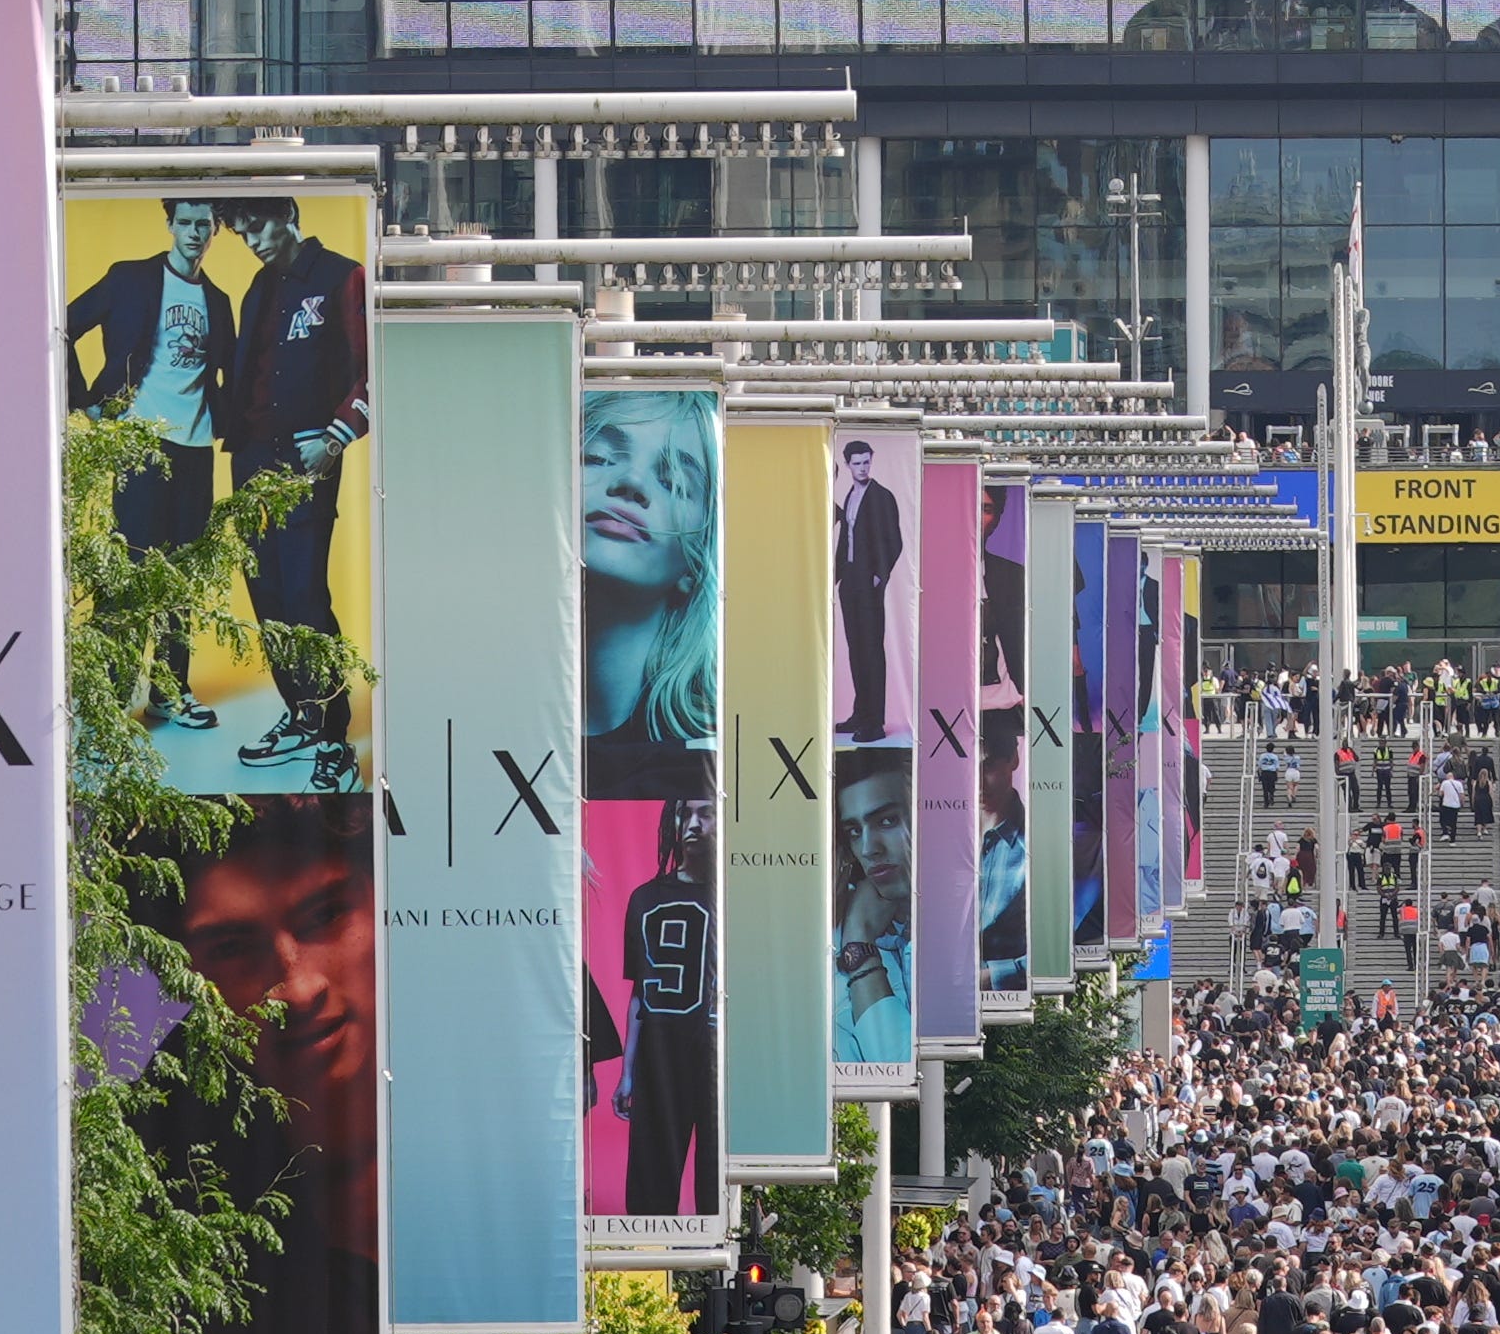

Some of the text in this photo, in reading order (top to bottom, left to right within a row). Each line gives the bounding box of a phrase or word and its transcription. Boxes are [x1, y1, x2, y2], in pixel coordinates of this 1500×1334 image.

[1394, 478, 1477, 499] FRONT
[1373, 514, 1500, 535] STANDING
[730, 851, 820, 867] EXCHANGE
[441, 908, 564, 927] EXCHANGE
[1419, 1182, 1436, 1193] 25
[607, 1218, 710, 1234] EXCHANGE
